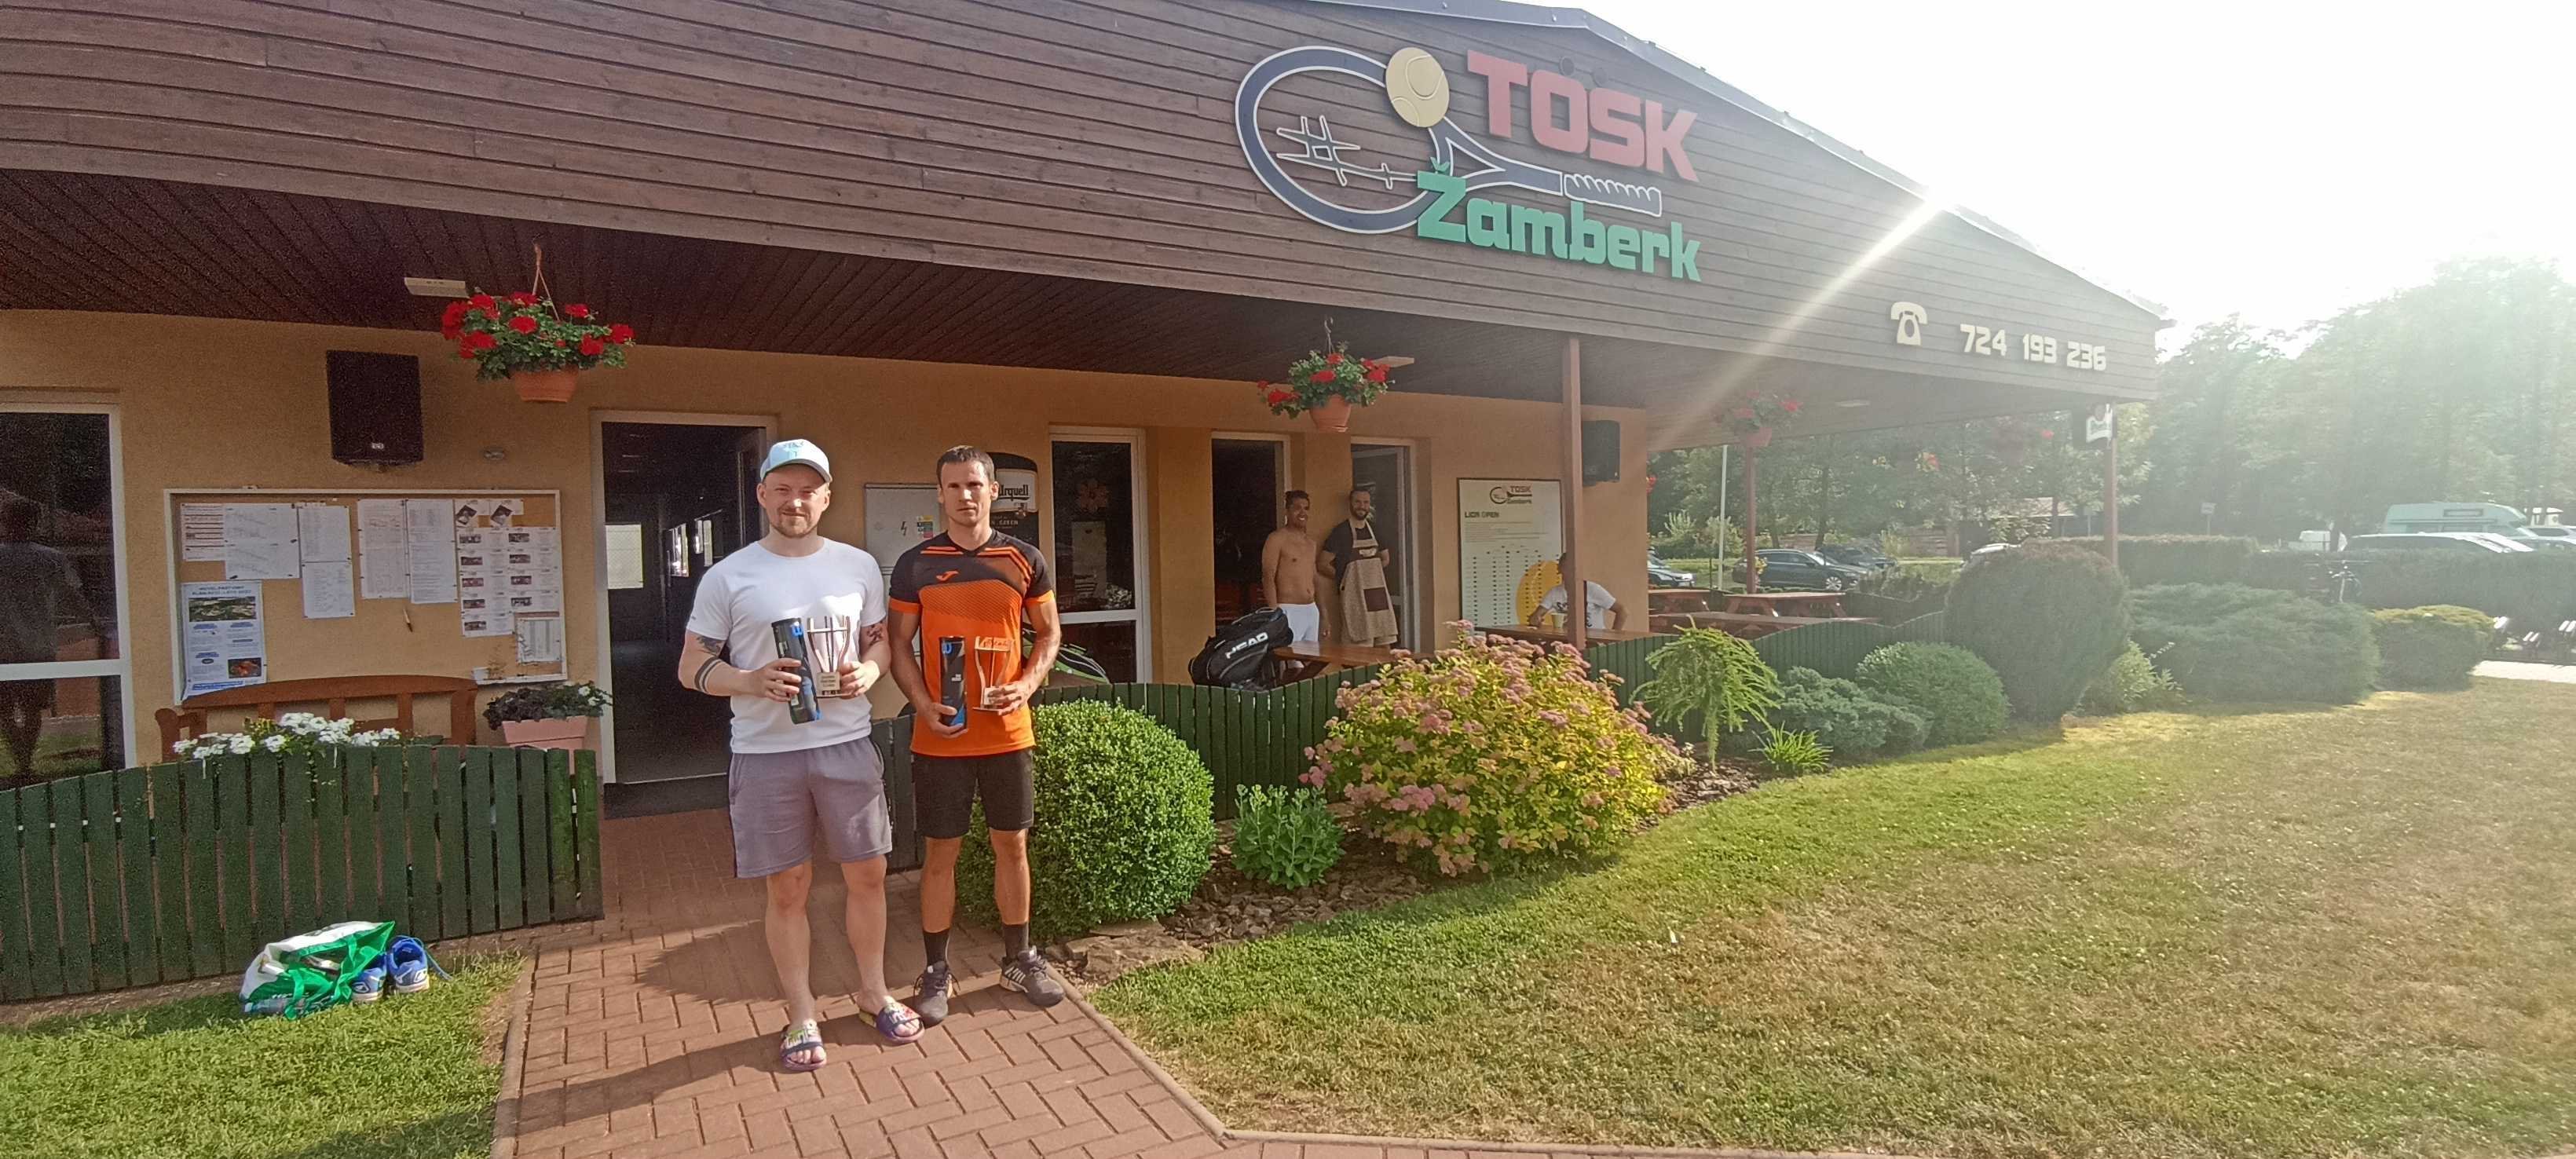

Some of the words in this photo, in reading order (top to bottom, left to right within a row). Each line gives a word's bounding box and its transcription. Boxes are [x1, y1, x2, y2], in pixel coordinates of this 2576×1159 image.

[1467, 49, 1699, 182] TOSK
[1417, 157, 1701, 282] Žamberk
[1959, 324, 2007, 356] 724
[2022, 333, 2057, 364] 193
[2066, 341, 2106, 371] 236
[1225, 631, 1269, 659] HEAD
